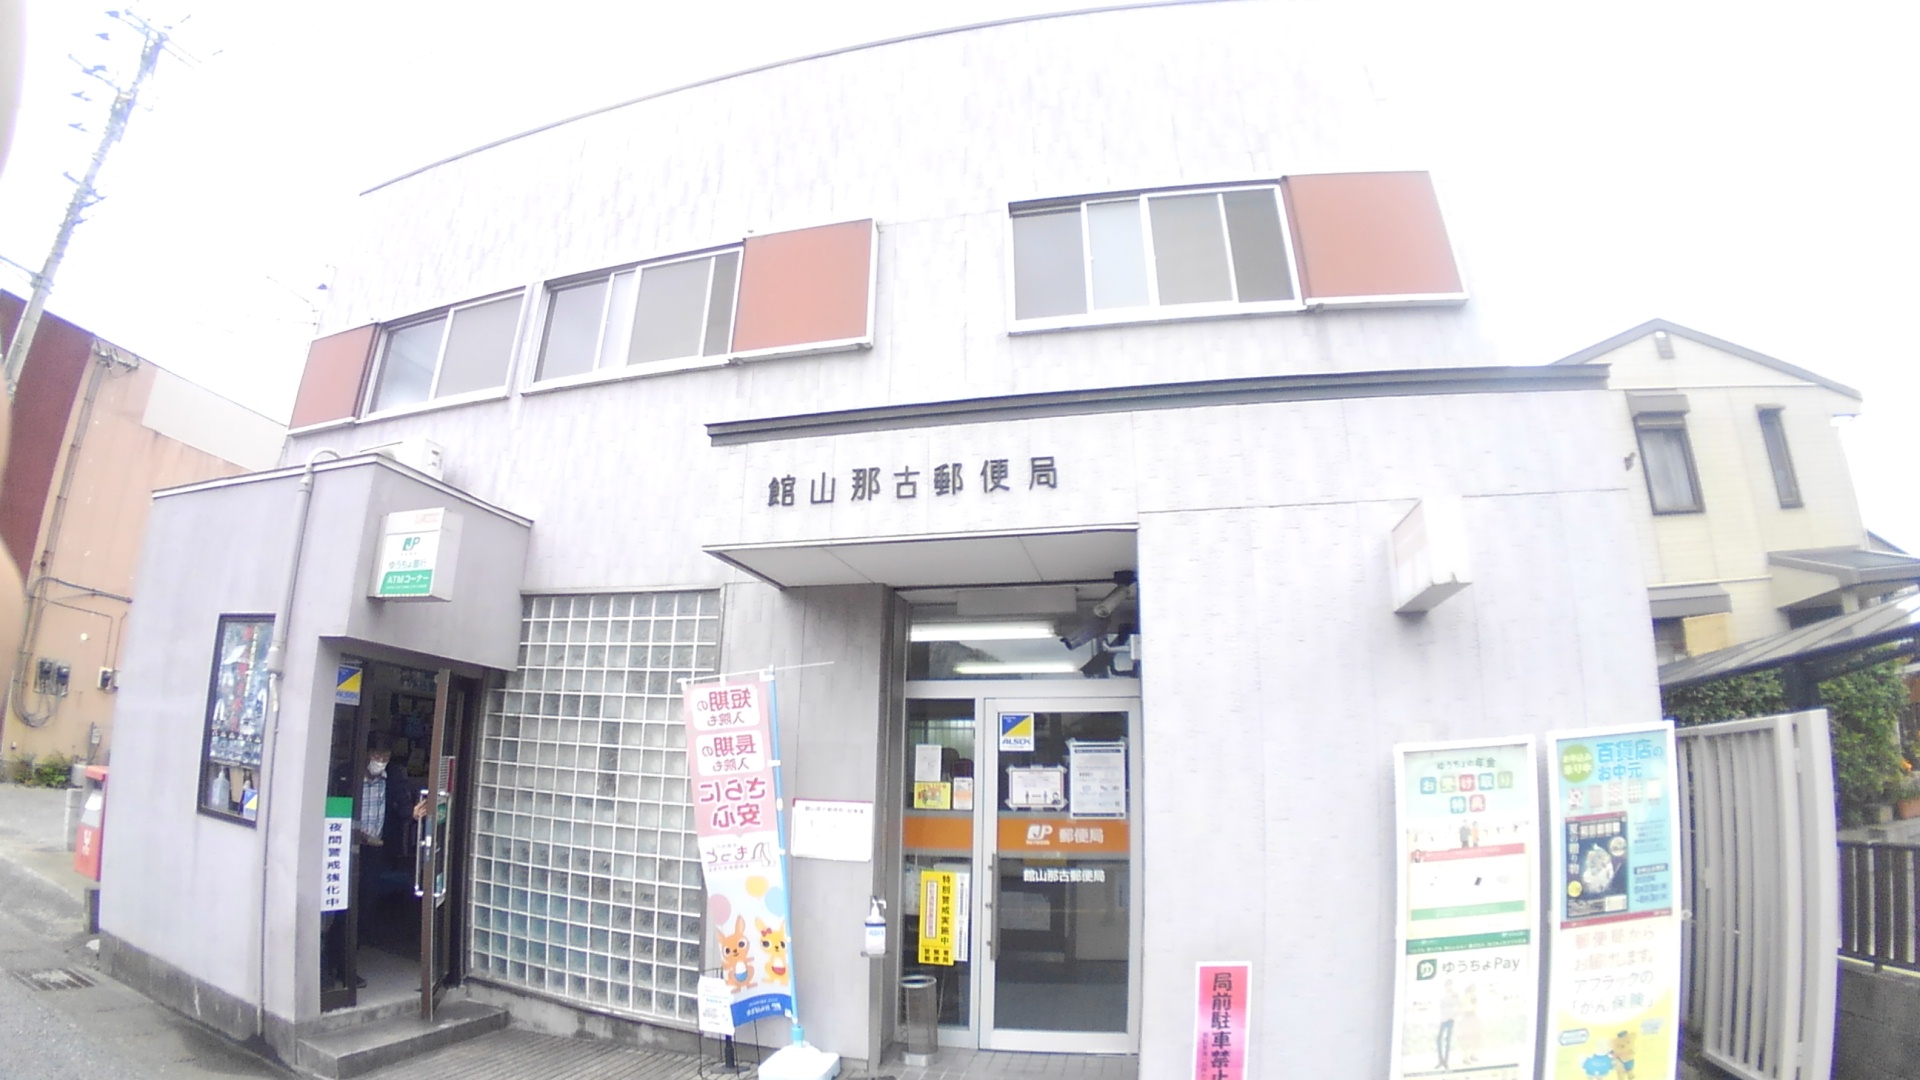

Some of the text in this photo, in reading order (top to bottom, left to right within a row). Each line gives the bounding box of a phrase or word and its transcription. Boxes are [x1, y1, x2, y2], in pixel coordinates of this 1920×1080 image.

[767, 456, 1058, 507] 館山那古郵便局
[386, 574, 429, 584] ATMコーナー
[1596, 738, 1663, 763] 百貨店の
[1598, 761, 1642, 781] お中元
[1059, 827, 1104, 843] 郵便局
[325, 822, 343, 907] 夜間警戒強化中
[1023, 868, 1106, 883] 館山那古郵便局
[1442, 957, 1521, 974] ゆうちょPay
